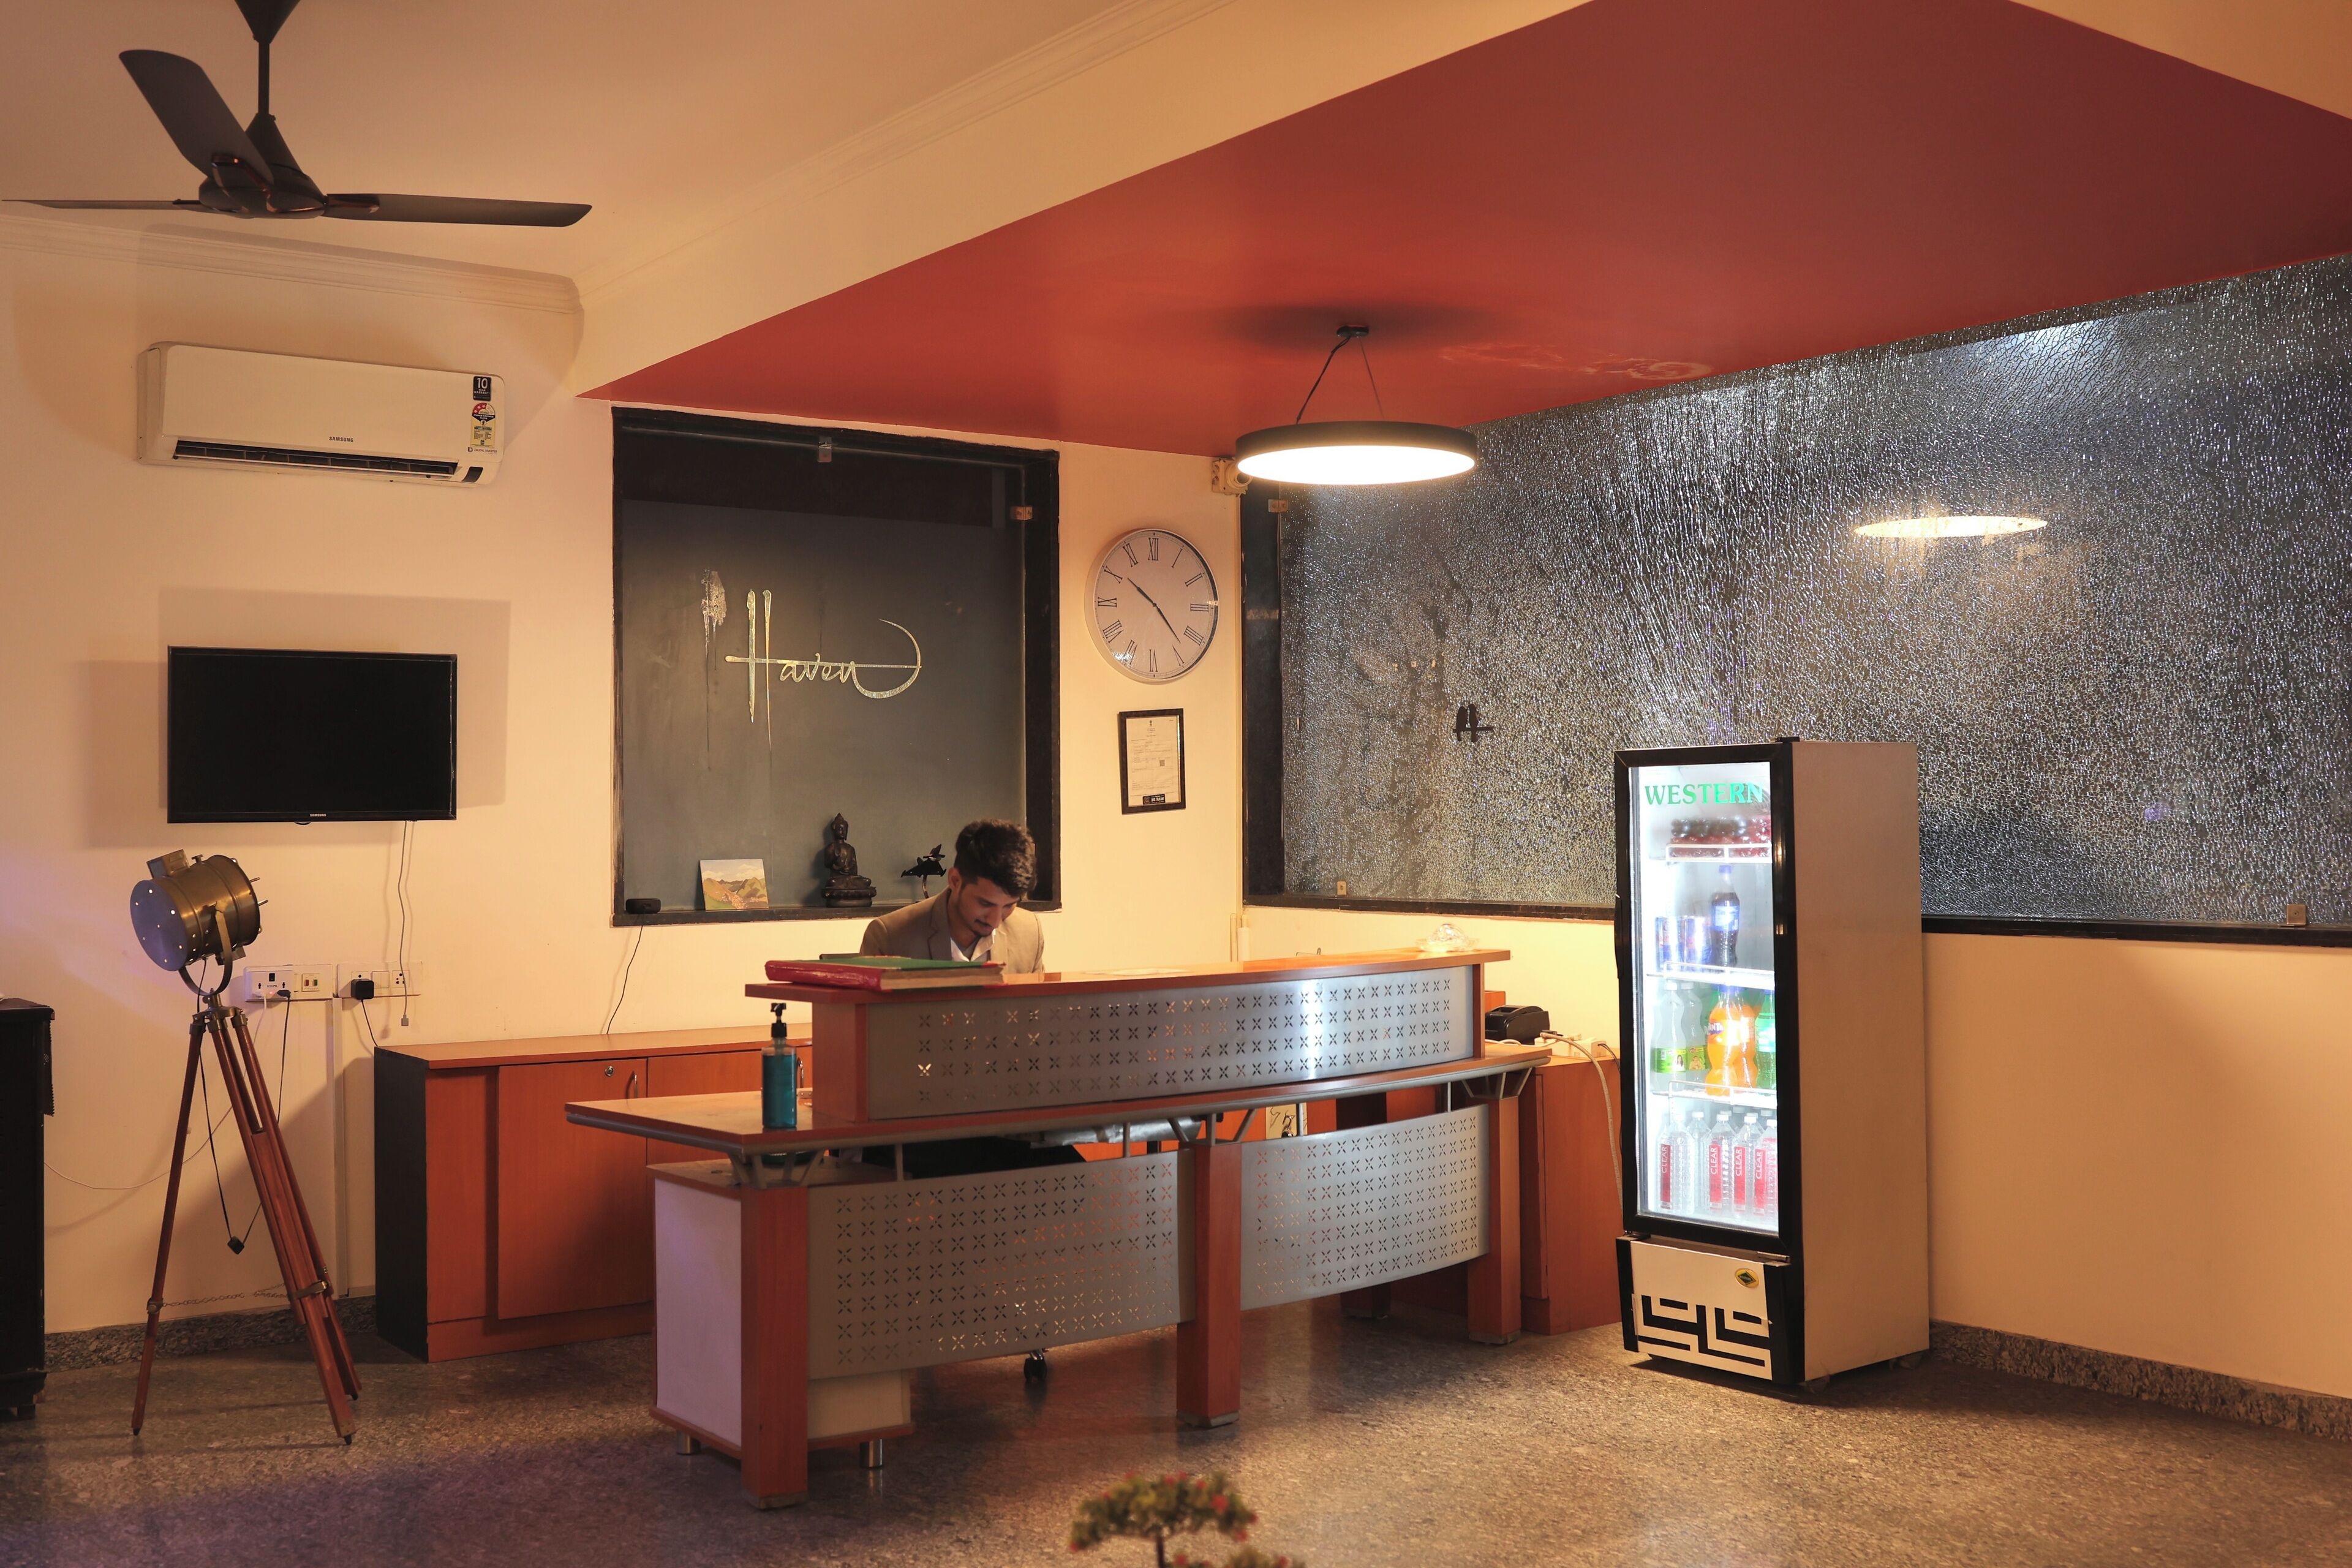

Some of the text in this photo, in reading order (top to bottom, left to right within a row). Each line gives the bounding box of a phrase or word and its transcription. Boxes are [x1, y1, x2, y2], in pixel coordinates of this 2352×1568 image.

[477, 377, 488, 389] 10
[725, 589, 922, 751] Haven
[1645, 782, 1765, 805] WESTERN
[1710, 1147, 1719, 1175] CLEAR
[1735, 1148, 1743, 1177] CLEAR
